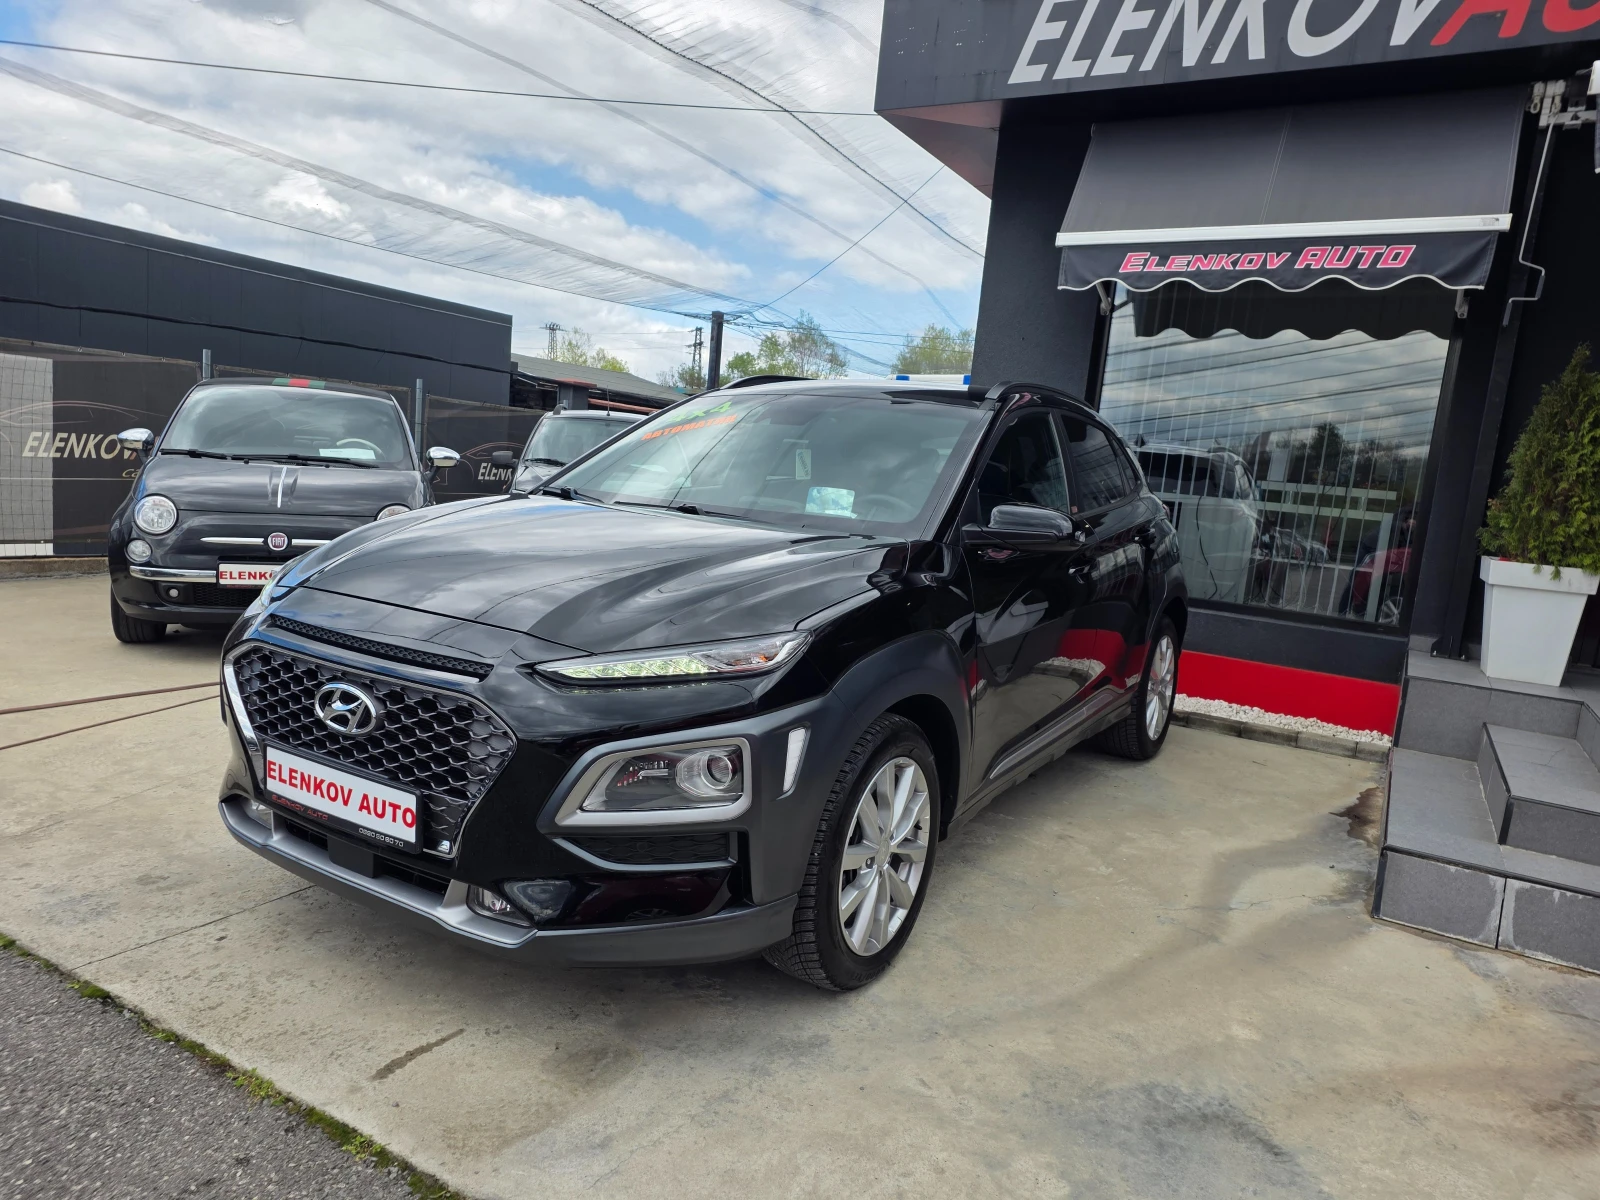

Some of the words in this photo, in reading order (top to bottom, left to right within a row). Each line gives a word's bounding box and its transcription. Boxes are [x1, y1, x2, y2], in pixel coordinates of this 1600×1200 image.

[1119, 251, 1291, 272] ELENKOV
[1294, 244, 1416, 269] AUTO
[272, 537, 285, 546] FIAT
[219, 570, 273, 581] ELENK
[267, 759, 353, 807] ELENKOV
[358, 793, 416, 829] AUTO
[307, 809, 328, 821] AUTO
